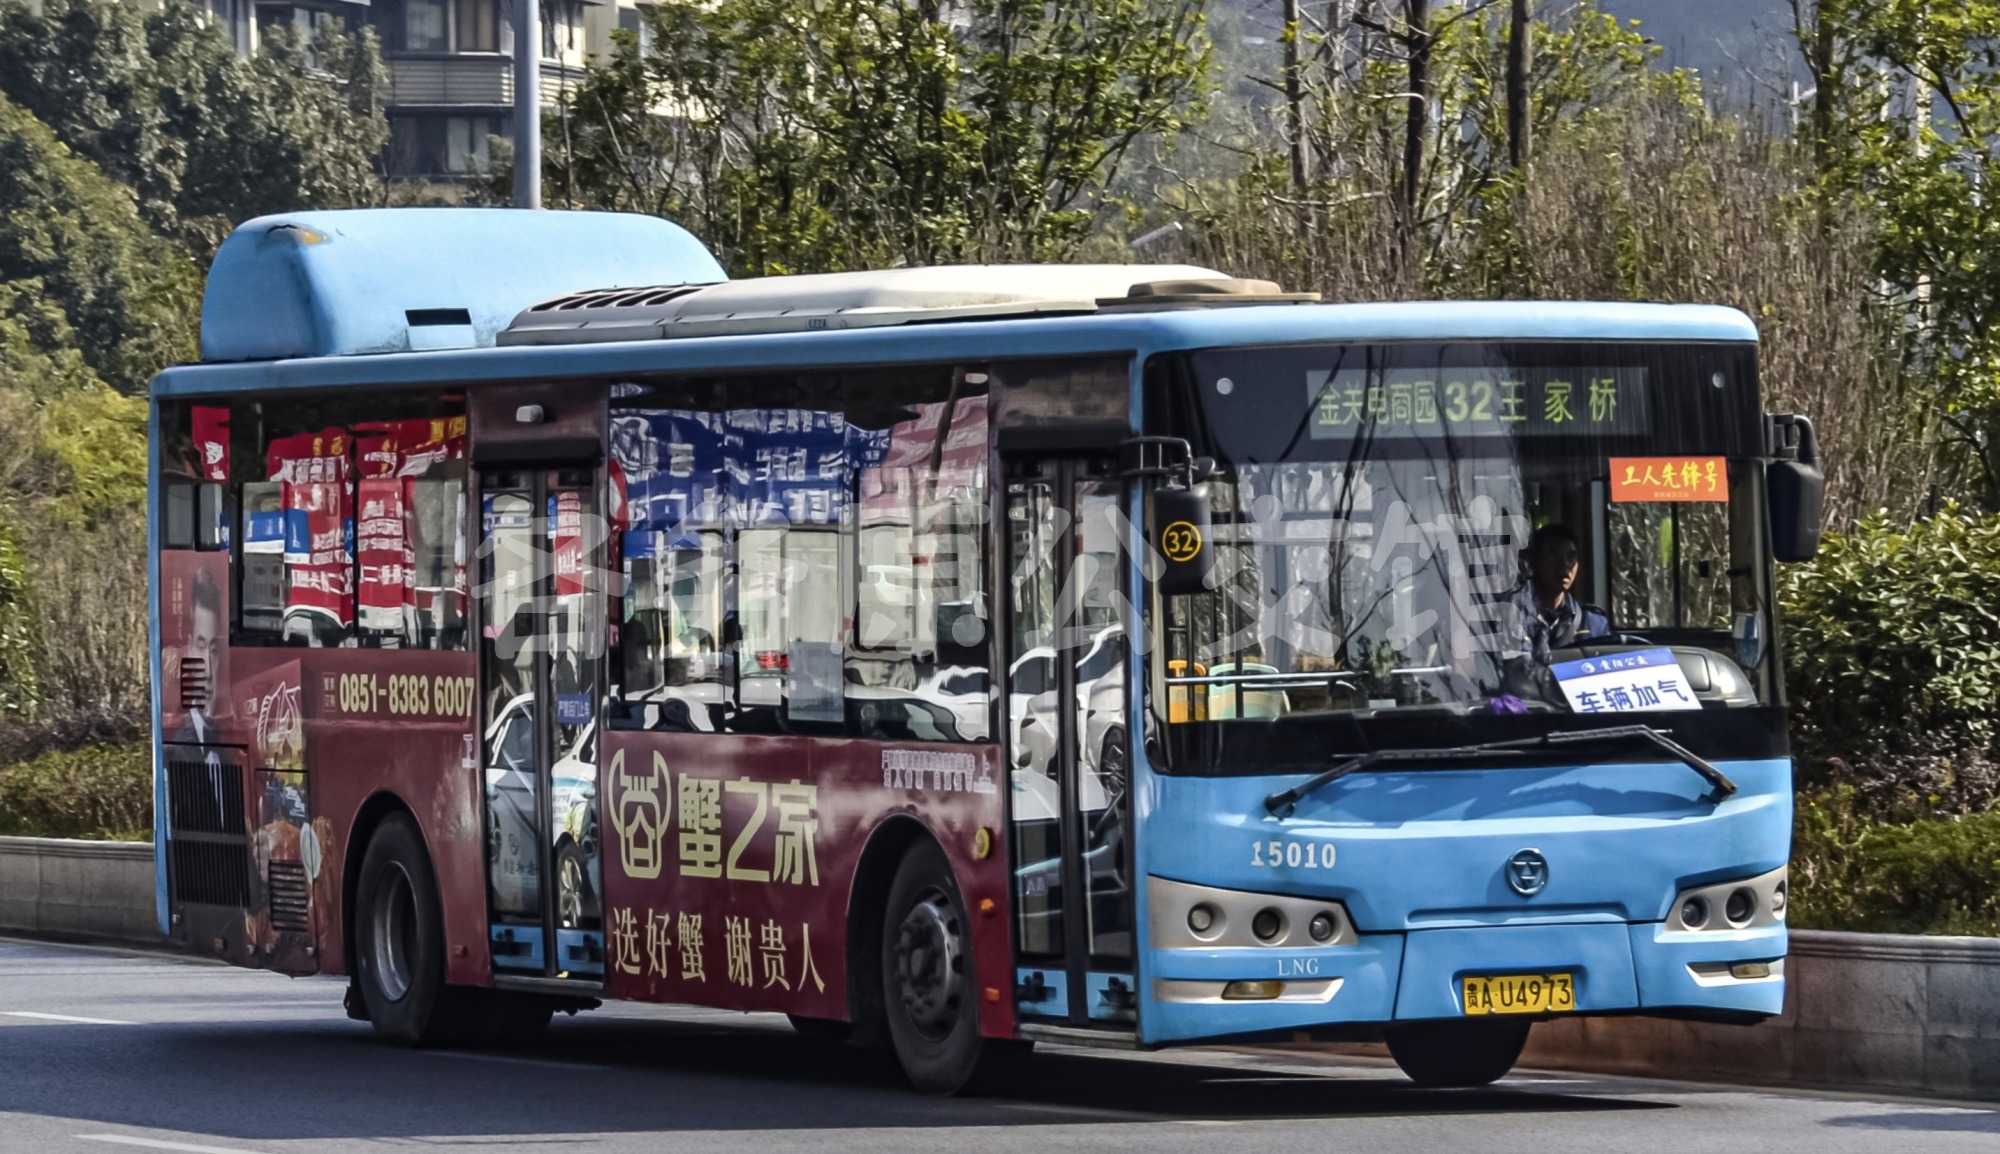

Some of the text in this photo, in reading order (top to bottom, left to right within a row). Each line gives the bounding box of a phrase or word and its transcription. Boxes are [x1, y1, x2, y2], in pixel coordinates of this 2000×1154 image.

[1445, 380, 1493, 421] 32
[1620, 460, 1719, 493] 工人先锋号
[1168, 530, 1194, 553] 32
[1575, 679, 1689, 713] 车辆加气
[677, 772, 820, 887] 蟹之家
[1251, 840, 1337, 869] 15010
[1277, 957, 1320, 977] LNG
